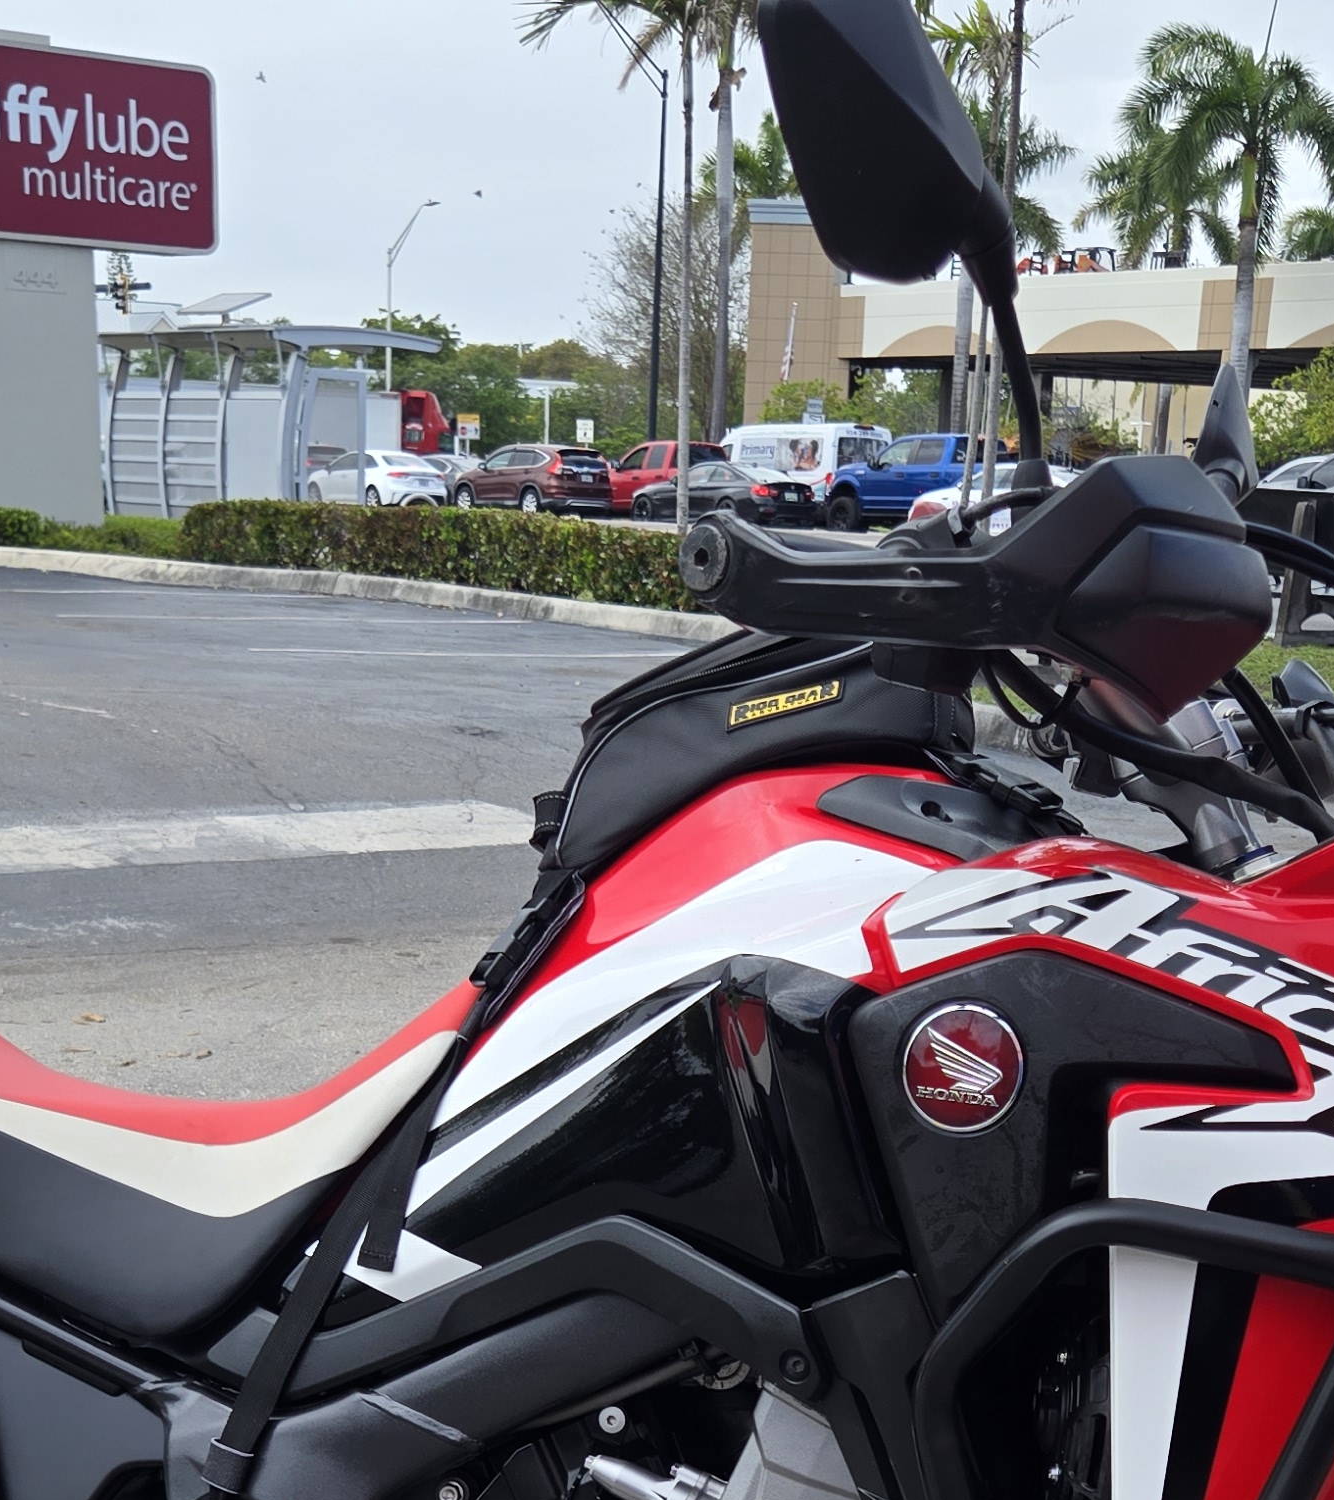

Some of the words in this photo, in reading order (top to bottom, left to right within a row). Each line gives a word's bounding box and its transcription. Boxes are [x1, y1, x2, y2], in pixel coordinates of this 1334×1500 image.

[85, 93, 189, 161] lube
[23, 162, 191, 211] multicare
[741, 444, 775, 459] Primary
[915, 1085, 1000, 1108] HONDA
